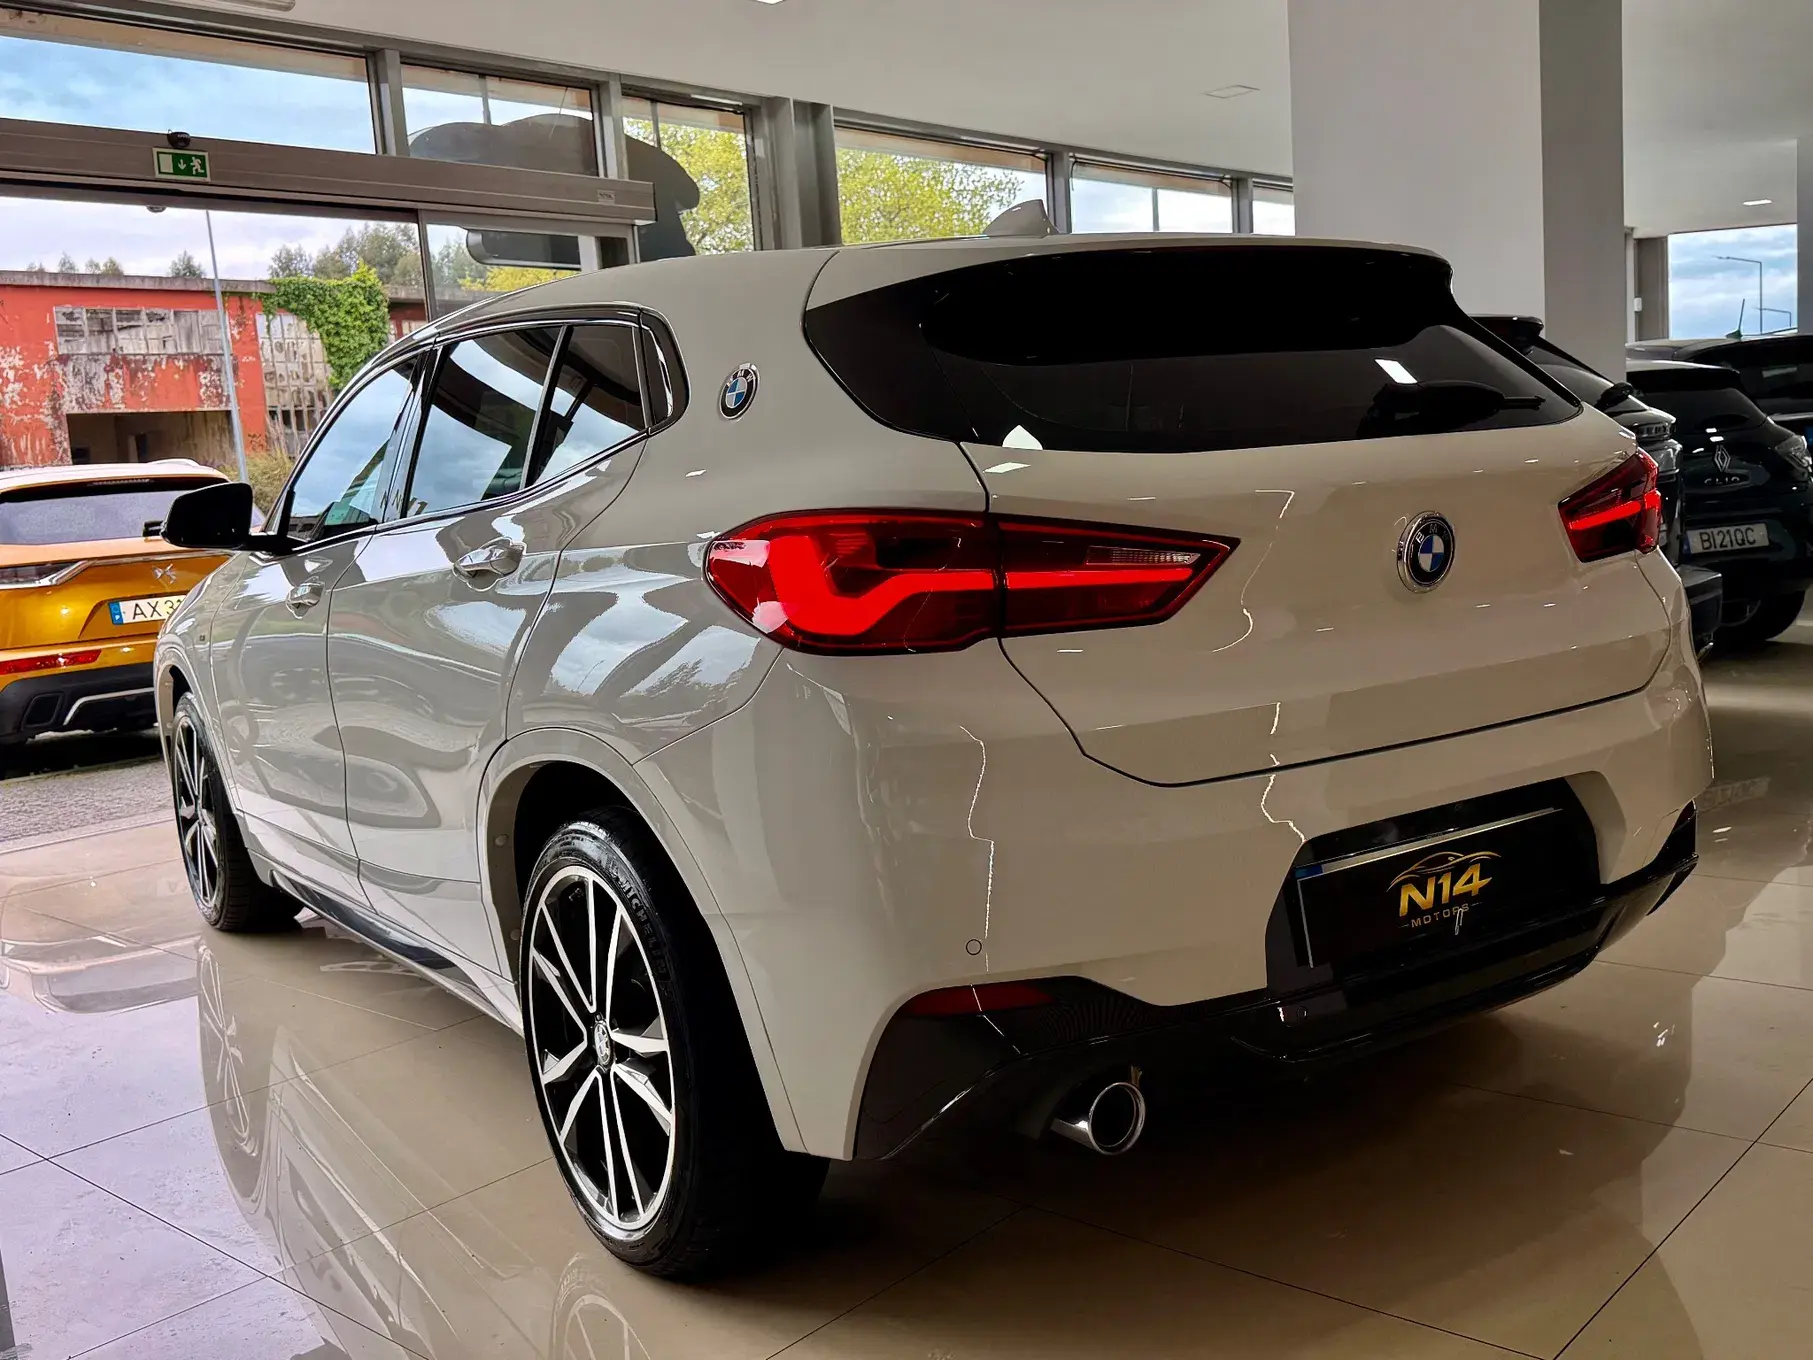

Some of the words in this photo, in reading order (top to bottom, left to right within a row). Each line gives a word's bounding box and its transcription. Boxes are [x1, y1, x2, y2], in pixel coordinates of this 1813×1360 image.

[1699, 527, 1757, 550] BI21QC
[1399, 863, 1492, 917] N14
[1411, 903, 1470, 928] MOTORS
